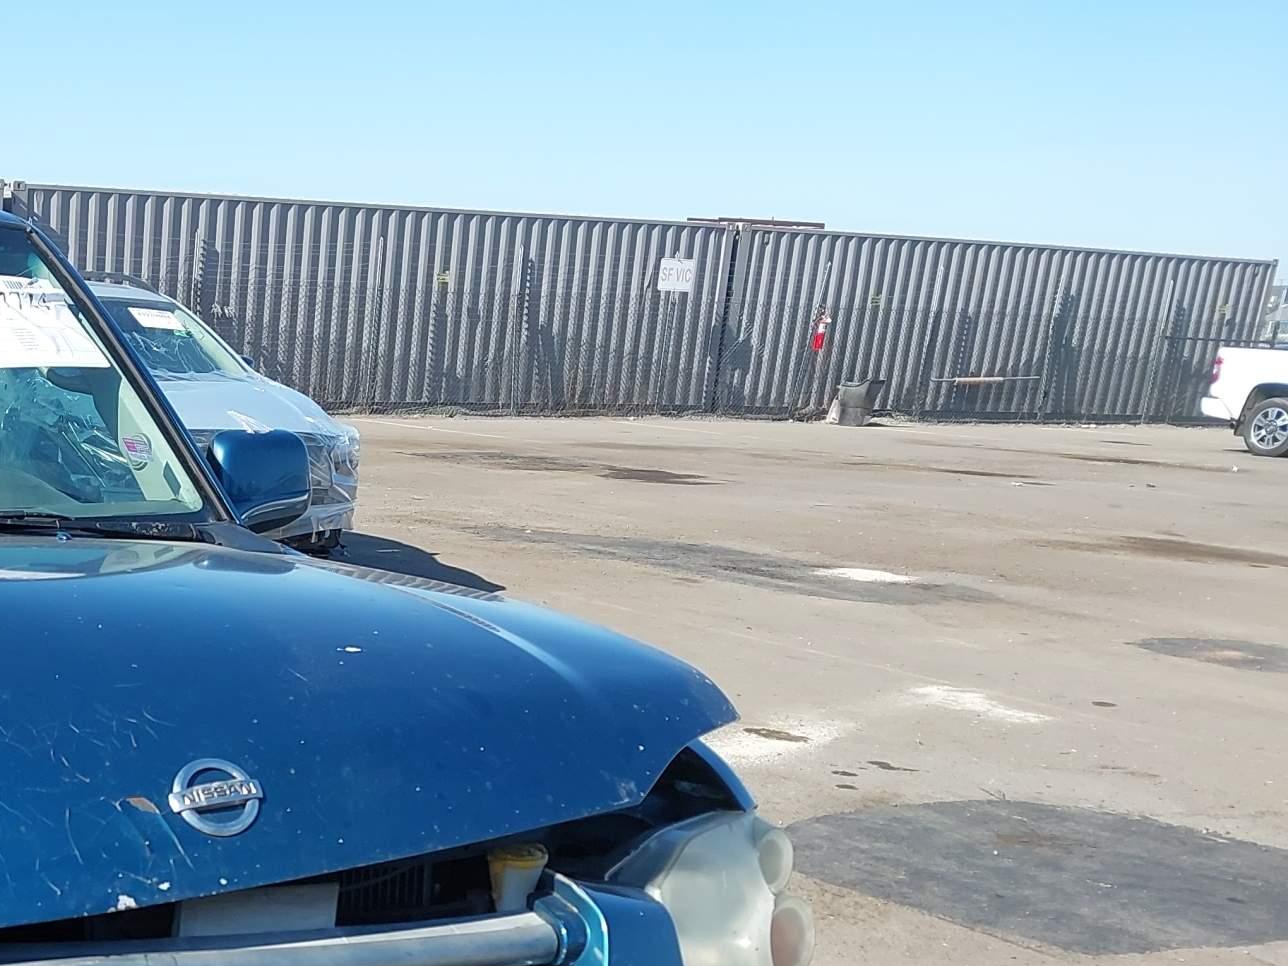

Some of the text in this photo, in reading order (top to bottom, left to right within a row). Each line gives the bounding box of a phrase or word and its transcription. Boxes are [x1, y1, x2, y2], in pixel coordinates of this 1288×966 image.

[661, 266, 692, 283] SF VIC
[181, 781, 257, 806] NISSAN
